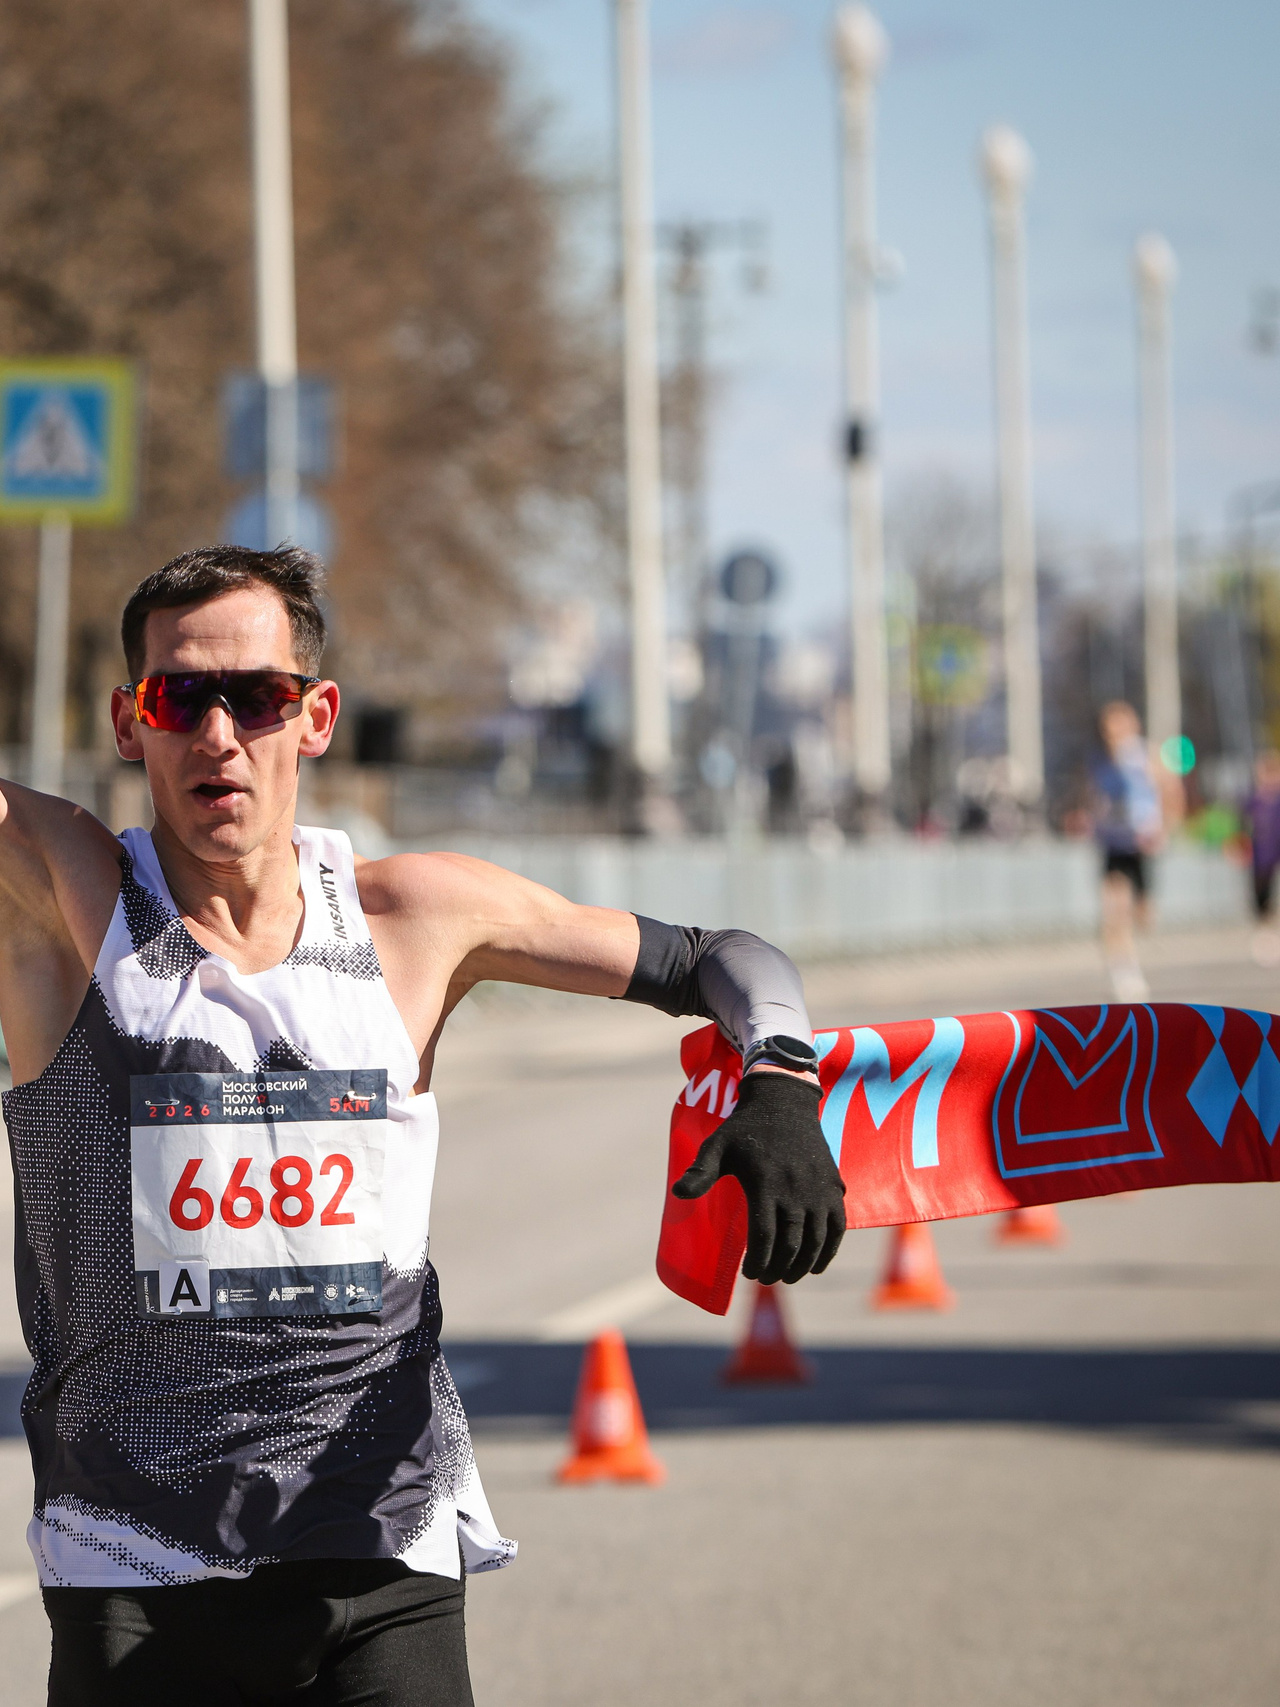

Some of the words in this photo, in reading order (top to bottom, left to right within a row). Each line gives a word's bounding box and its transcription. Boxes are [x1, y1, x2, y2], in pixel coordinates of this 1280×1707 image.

[318, 862, 348, 940] INSANITY
[222, 1104, 285, 1116] МАРАФОН
[169, 1153, 355, 1231] 6682
[168, 1268, 202, 1307] A
